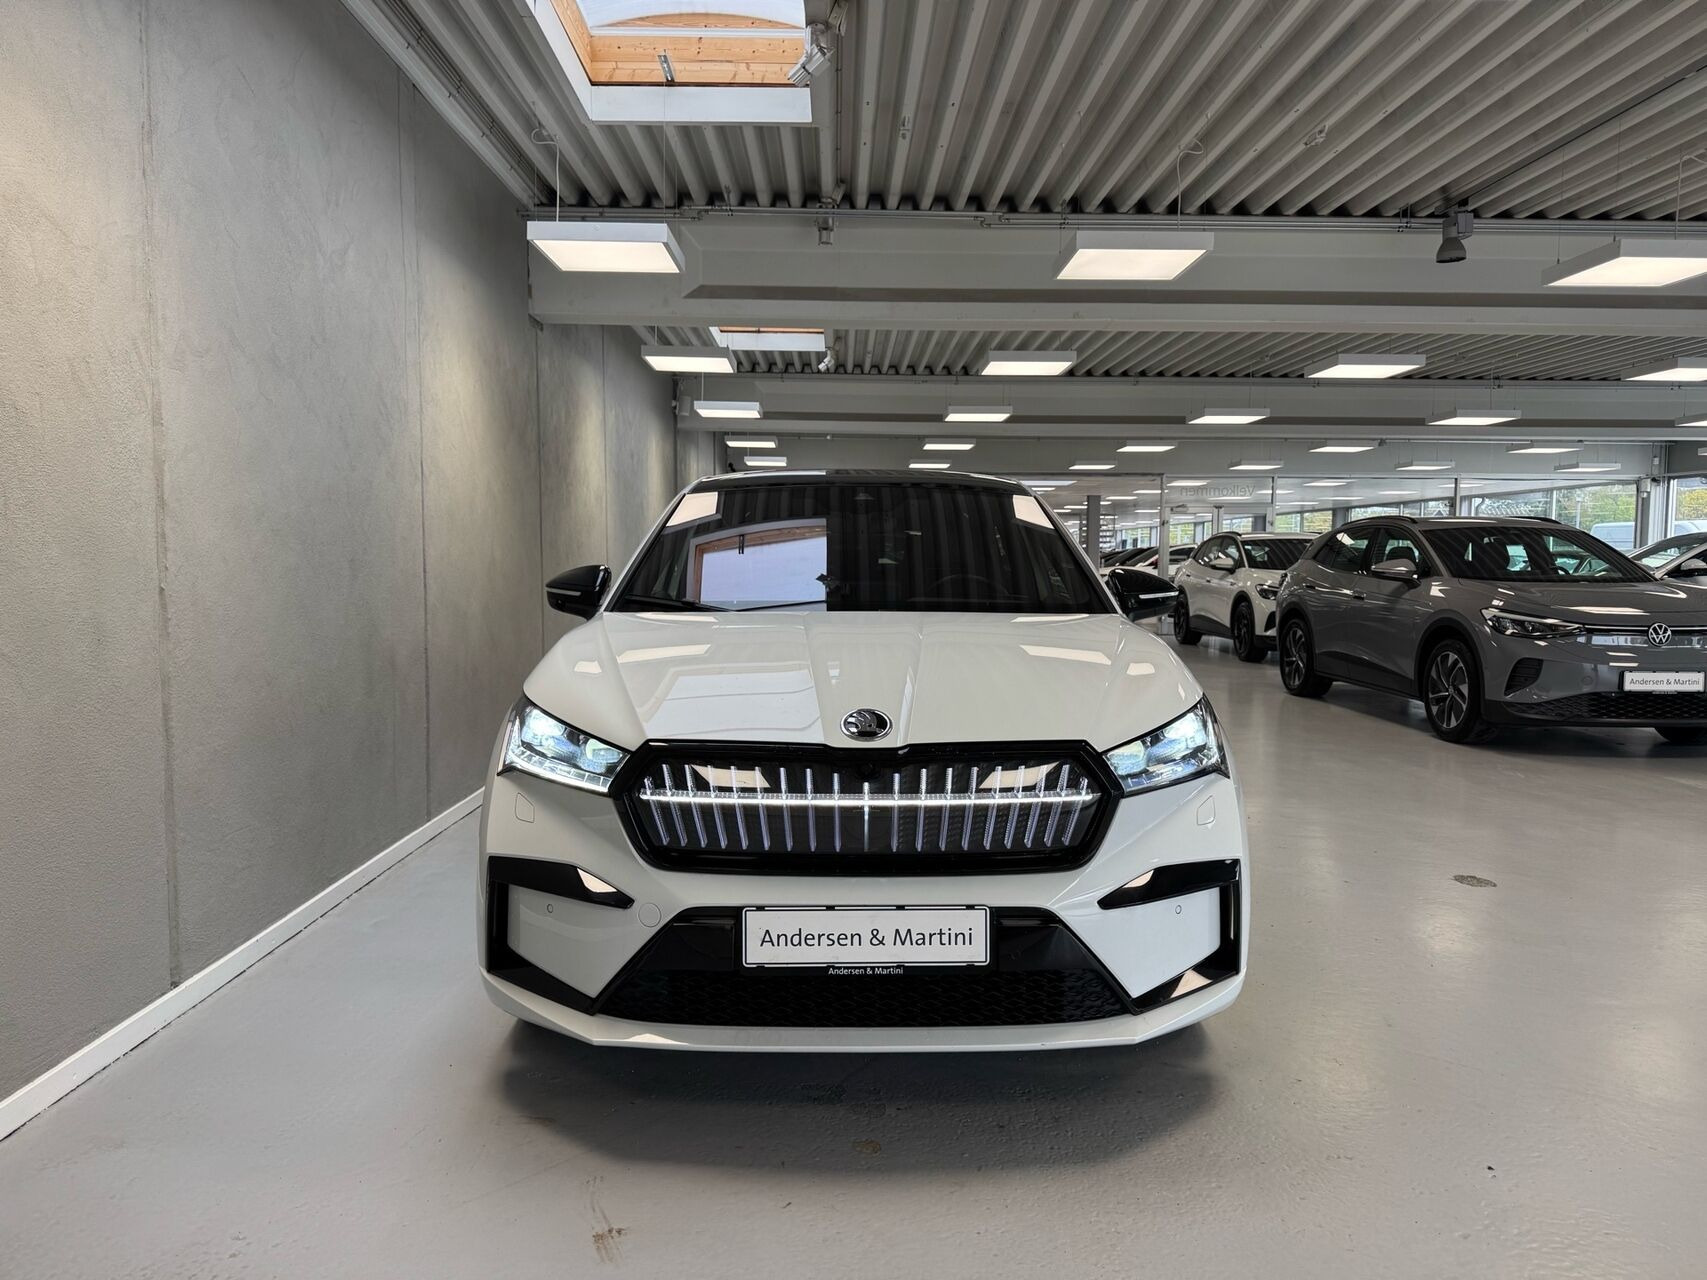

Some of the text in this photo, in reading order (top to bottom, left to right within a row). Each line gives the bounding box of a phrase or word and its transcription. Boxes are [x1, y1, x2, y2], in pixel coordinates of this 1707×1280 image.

[1629, 678, 1665, 686] Andersen
[760, 927, 973, 947] Andersen & Martini
[828, 966, 904, 975] Andersen & Martini
